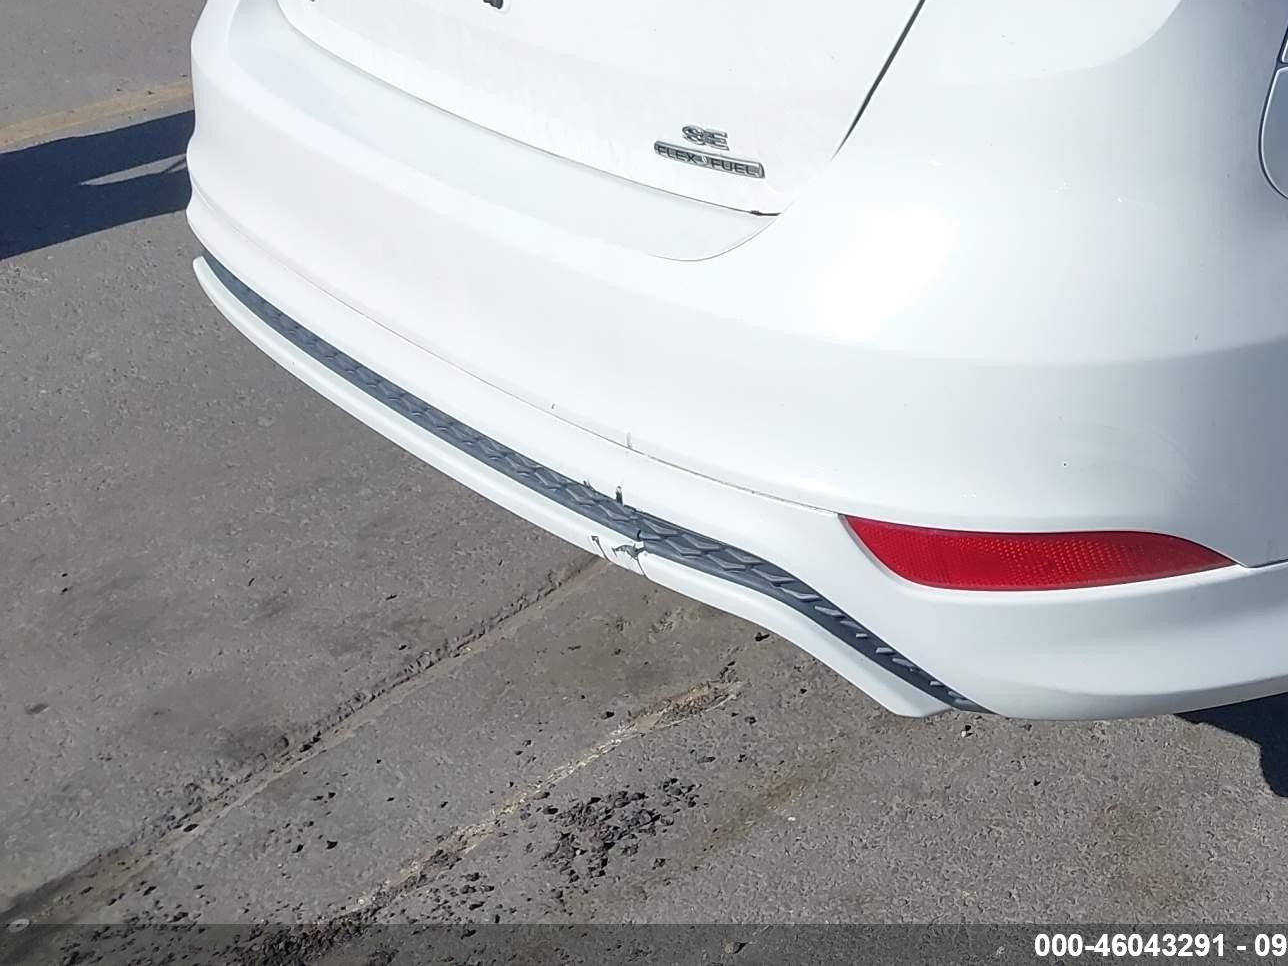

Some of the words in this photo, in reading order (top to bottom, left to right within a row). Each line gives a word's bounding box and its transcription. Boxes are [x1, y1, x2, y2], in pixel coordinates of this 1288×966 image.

[681, 124, 730, 152] SE
[656, 144, 698, 164] FLEX
[710, 157, 761, 177] FUEL
